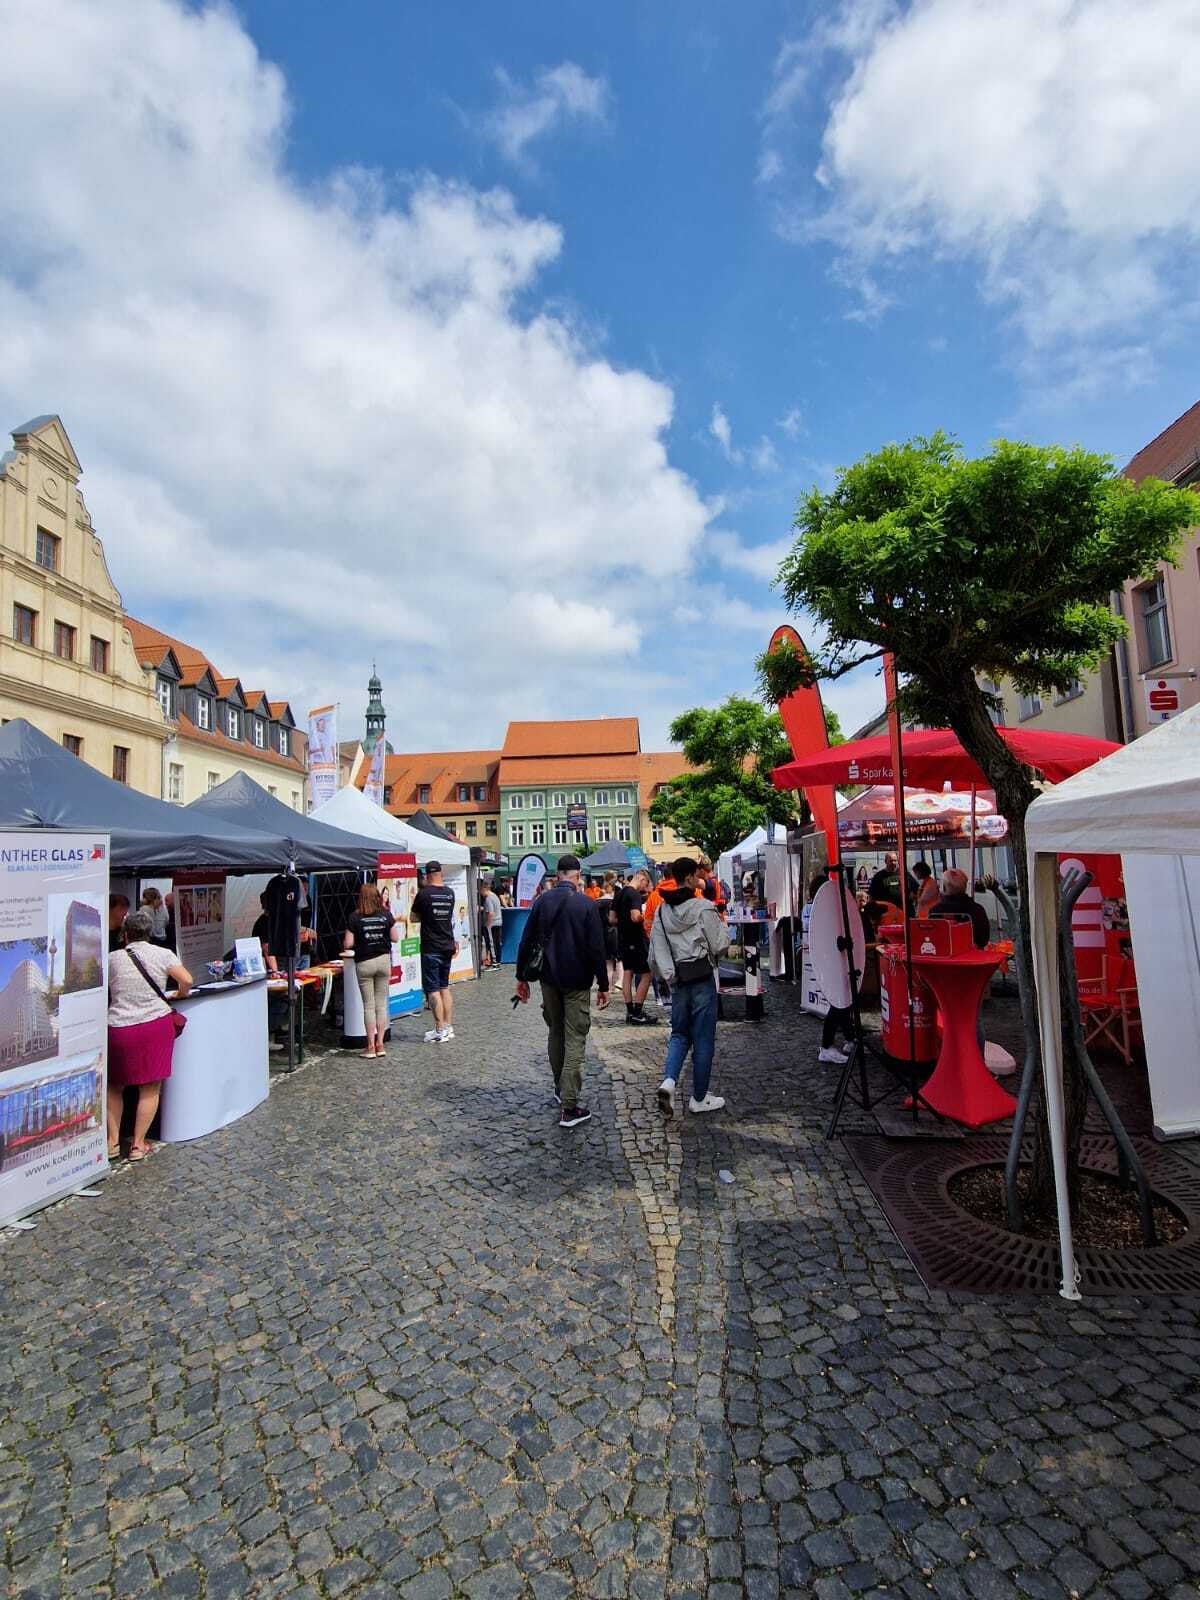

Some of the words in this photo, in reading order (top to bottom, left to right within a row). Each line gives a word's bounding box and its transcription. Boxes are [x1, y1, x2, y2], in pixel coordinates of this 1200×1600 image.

[863, 767, 908, 780] Sparkae
[51, 849, 84, 862] GLAS
[24, 1137, 104, 1178] www.koelling.info
